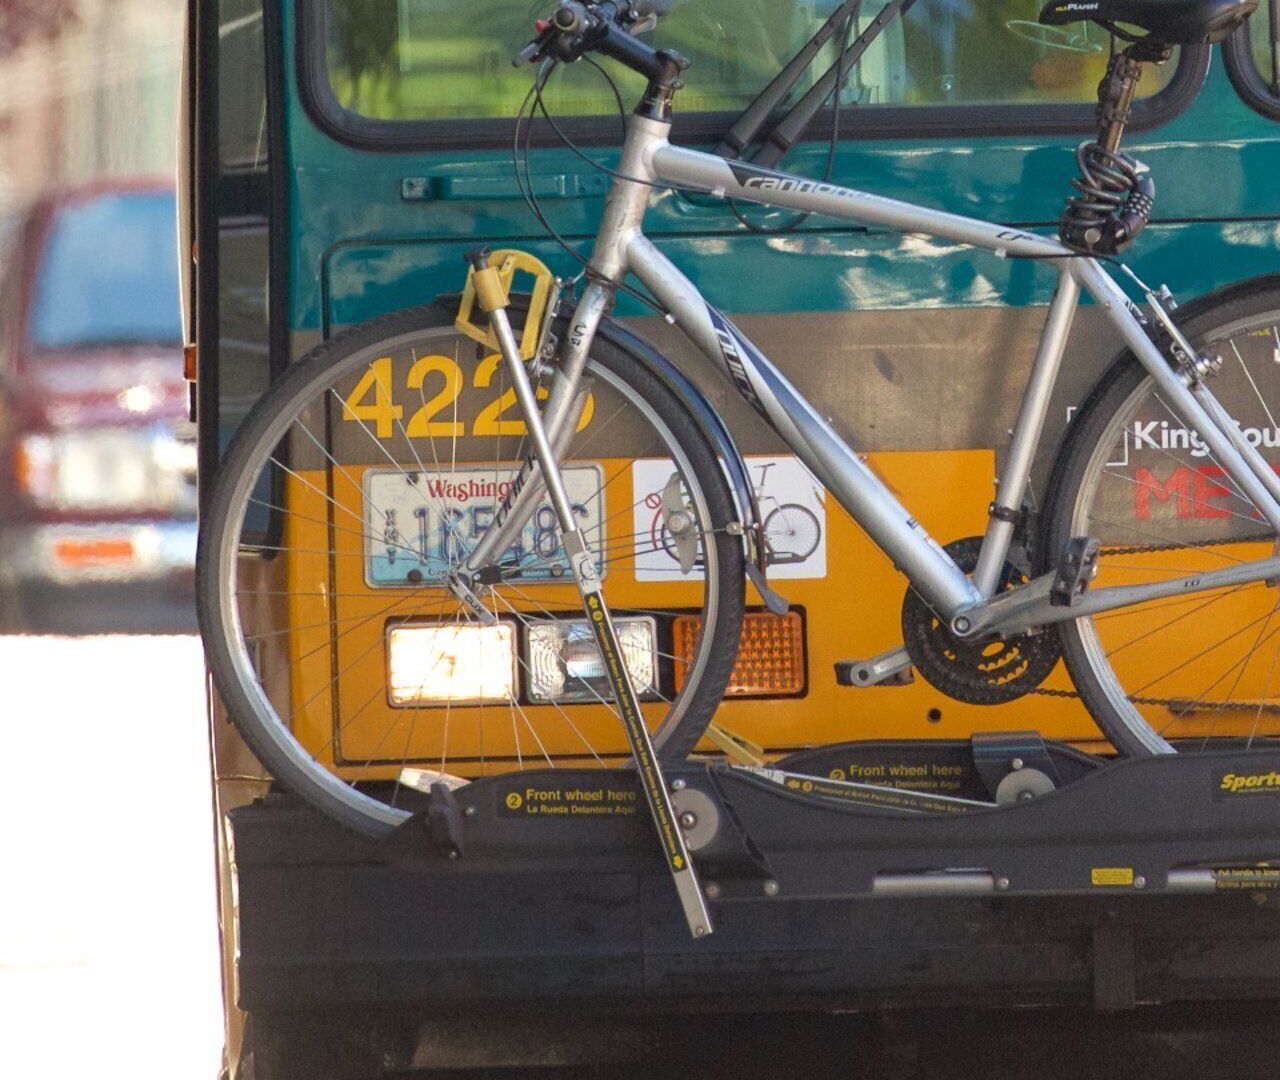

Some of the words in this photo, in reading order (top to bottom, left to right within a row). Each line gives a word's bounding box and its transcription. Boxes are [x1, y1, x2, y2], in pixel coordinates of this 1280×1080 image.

[342, 353, 596, 439] 422
[1134, 420, 1211, 457] King
[850, 765, 885, 776] Front
[889, 765, 927, 776] wheel
[932, 765, 962, 776] here
[526, 789, 561, 801] Front
[565, 789, 603, 801] wheel
[607, 789, 637, 801] here
